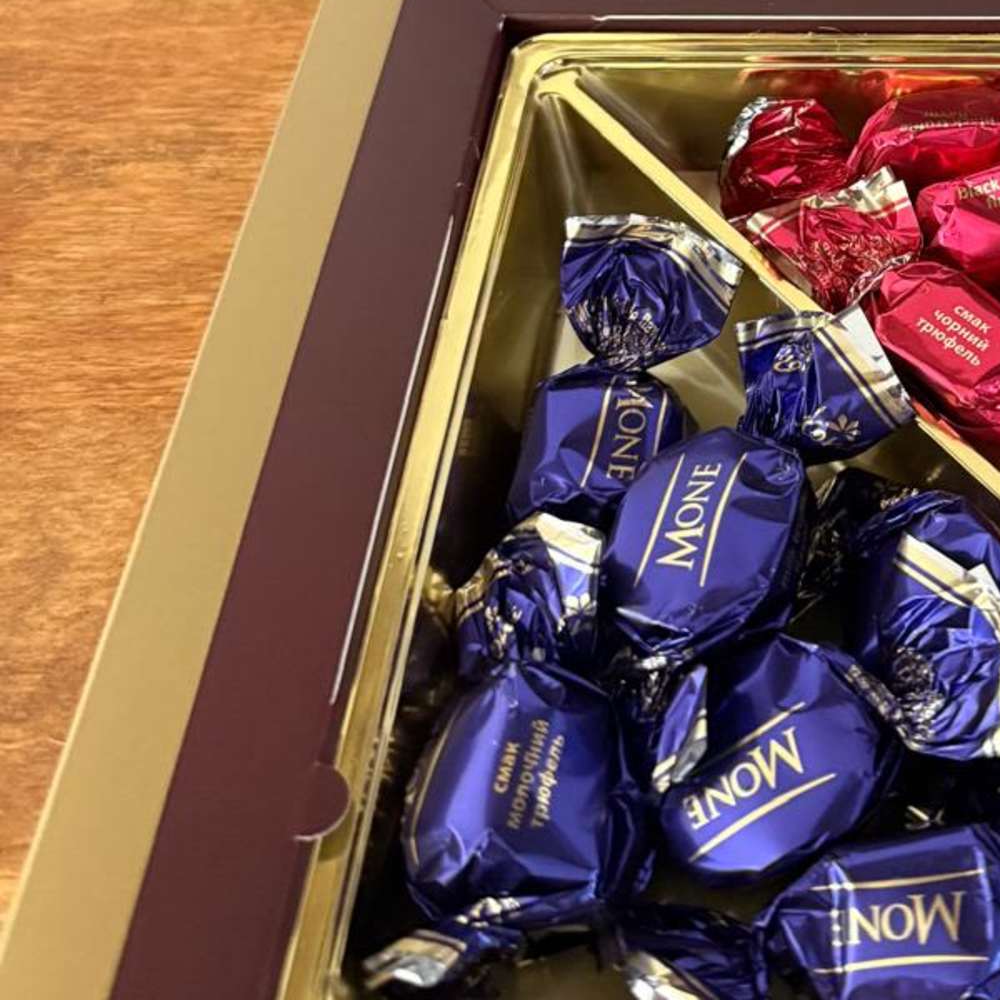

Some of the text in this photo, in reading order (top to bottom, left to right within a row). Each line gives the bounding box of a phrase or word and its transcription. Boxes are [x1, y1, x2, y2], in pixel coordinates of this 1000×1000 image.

[916, 316, 981, 367] трюфель
[933, 309, 989, 352] чорний
[953, 305, 991, 334] смак
[655, 461, 723, 571] MONE
[493, 741, 520, 794] смак
[529, 734, 565, 829] трюфель
[682, 726, 805, 830] MONE
